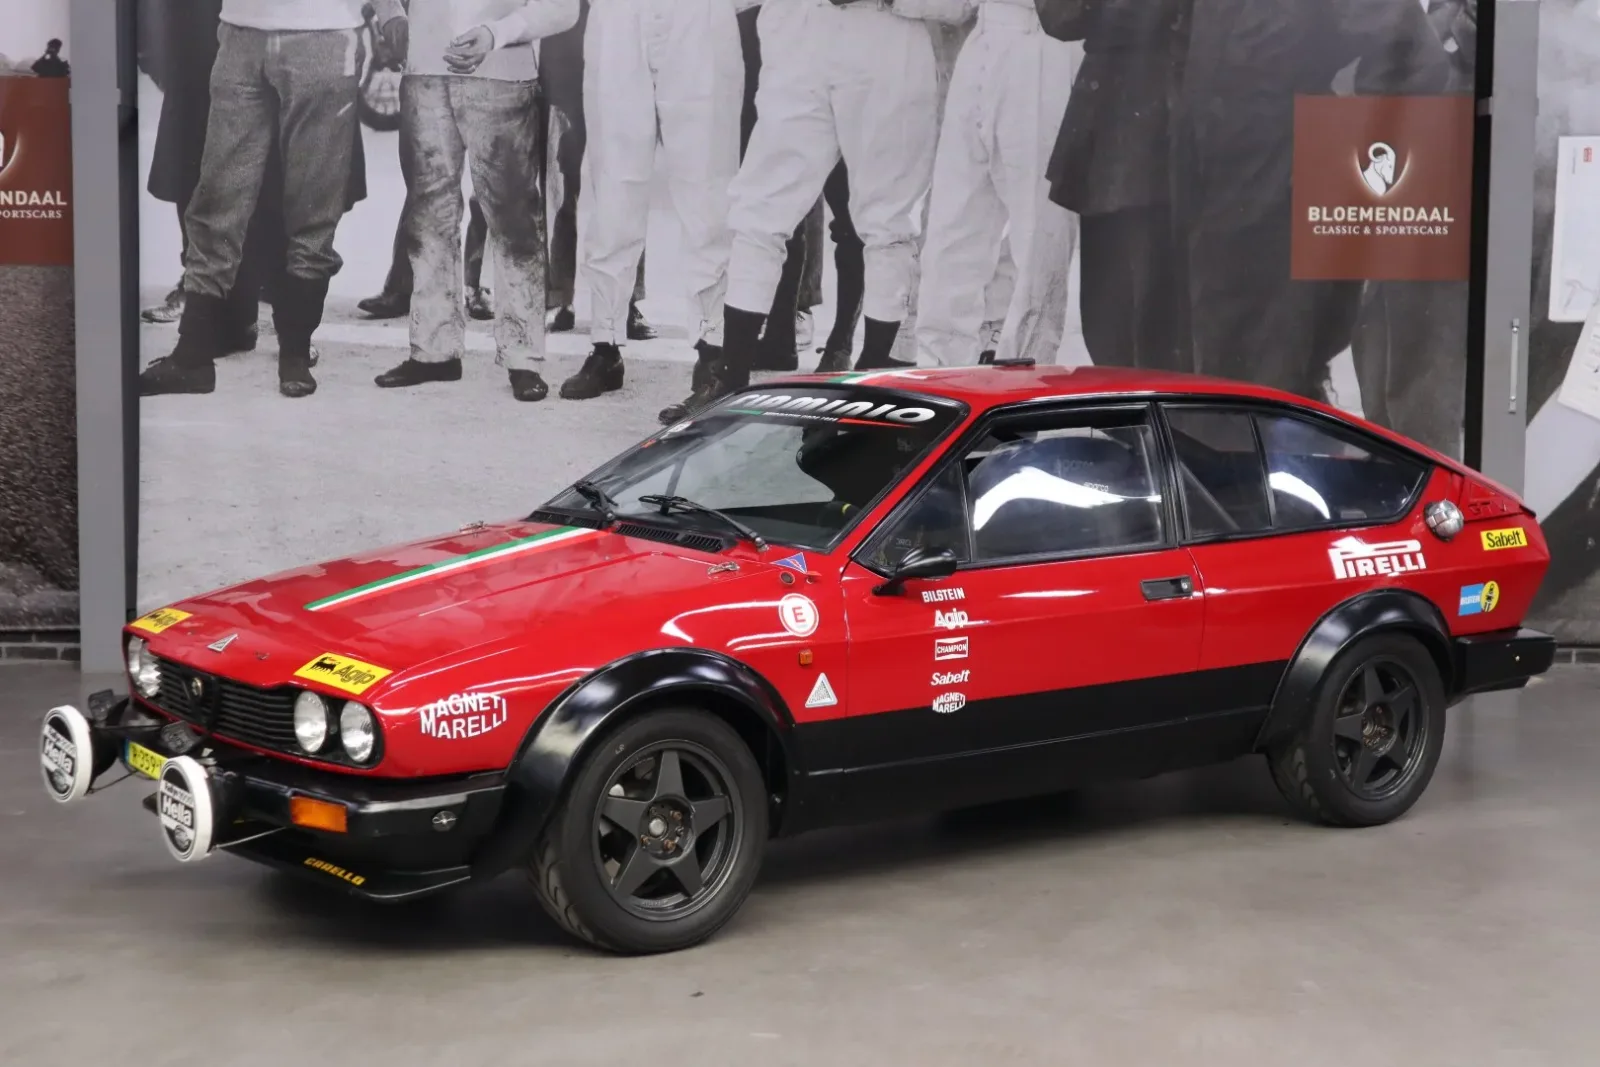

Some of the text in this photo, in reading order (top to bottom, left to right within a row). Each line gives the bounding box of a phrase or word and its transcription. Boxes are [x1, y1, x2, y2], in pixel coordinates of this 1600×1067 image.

[1307, 206, 1454, 223] BLOEMENDAAL
[1313, 225, 1449, 236] CLASSIC & SPORTSCARS
[1486, 530, 1523, 549] Sabelt
[1327, 535, 1427, 580] PIRELLI
[921, 587, 966, 603] BILSTEIN
[791, 606, 807, 623] E
[934, 607, 969, 630] Agip
[936, 643, 967, 654] CHAMPION
[333, 661, 377, 686] Agip
[930, 669, 971, 686] Sabelt
[44, 737, 73, 773] Hella
[162, 795, 192, 827] Hella
